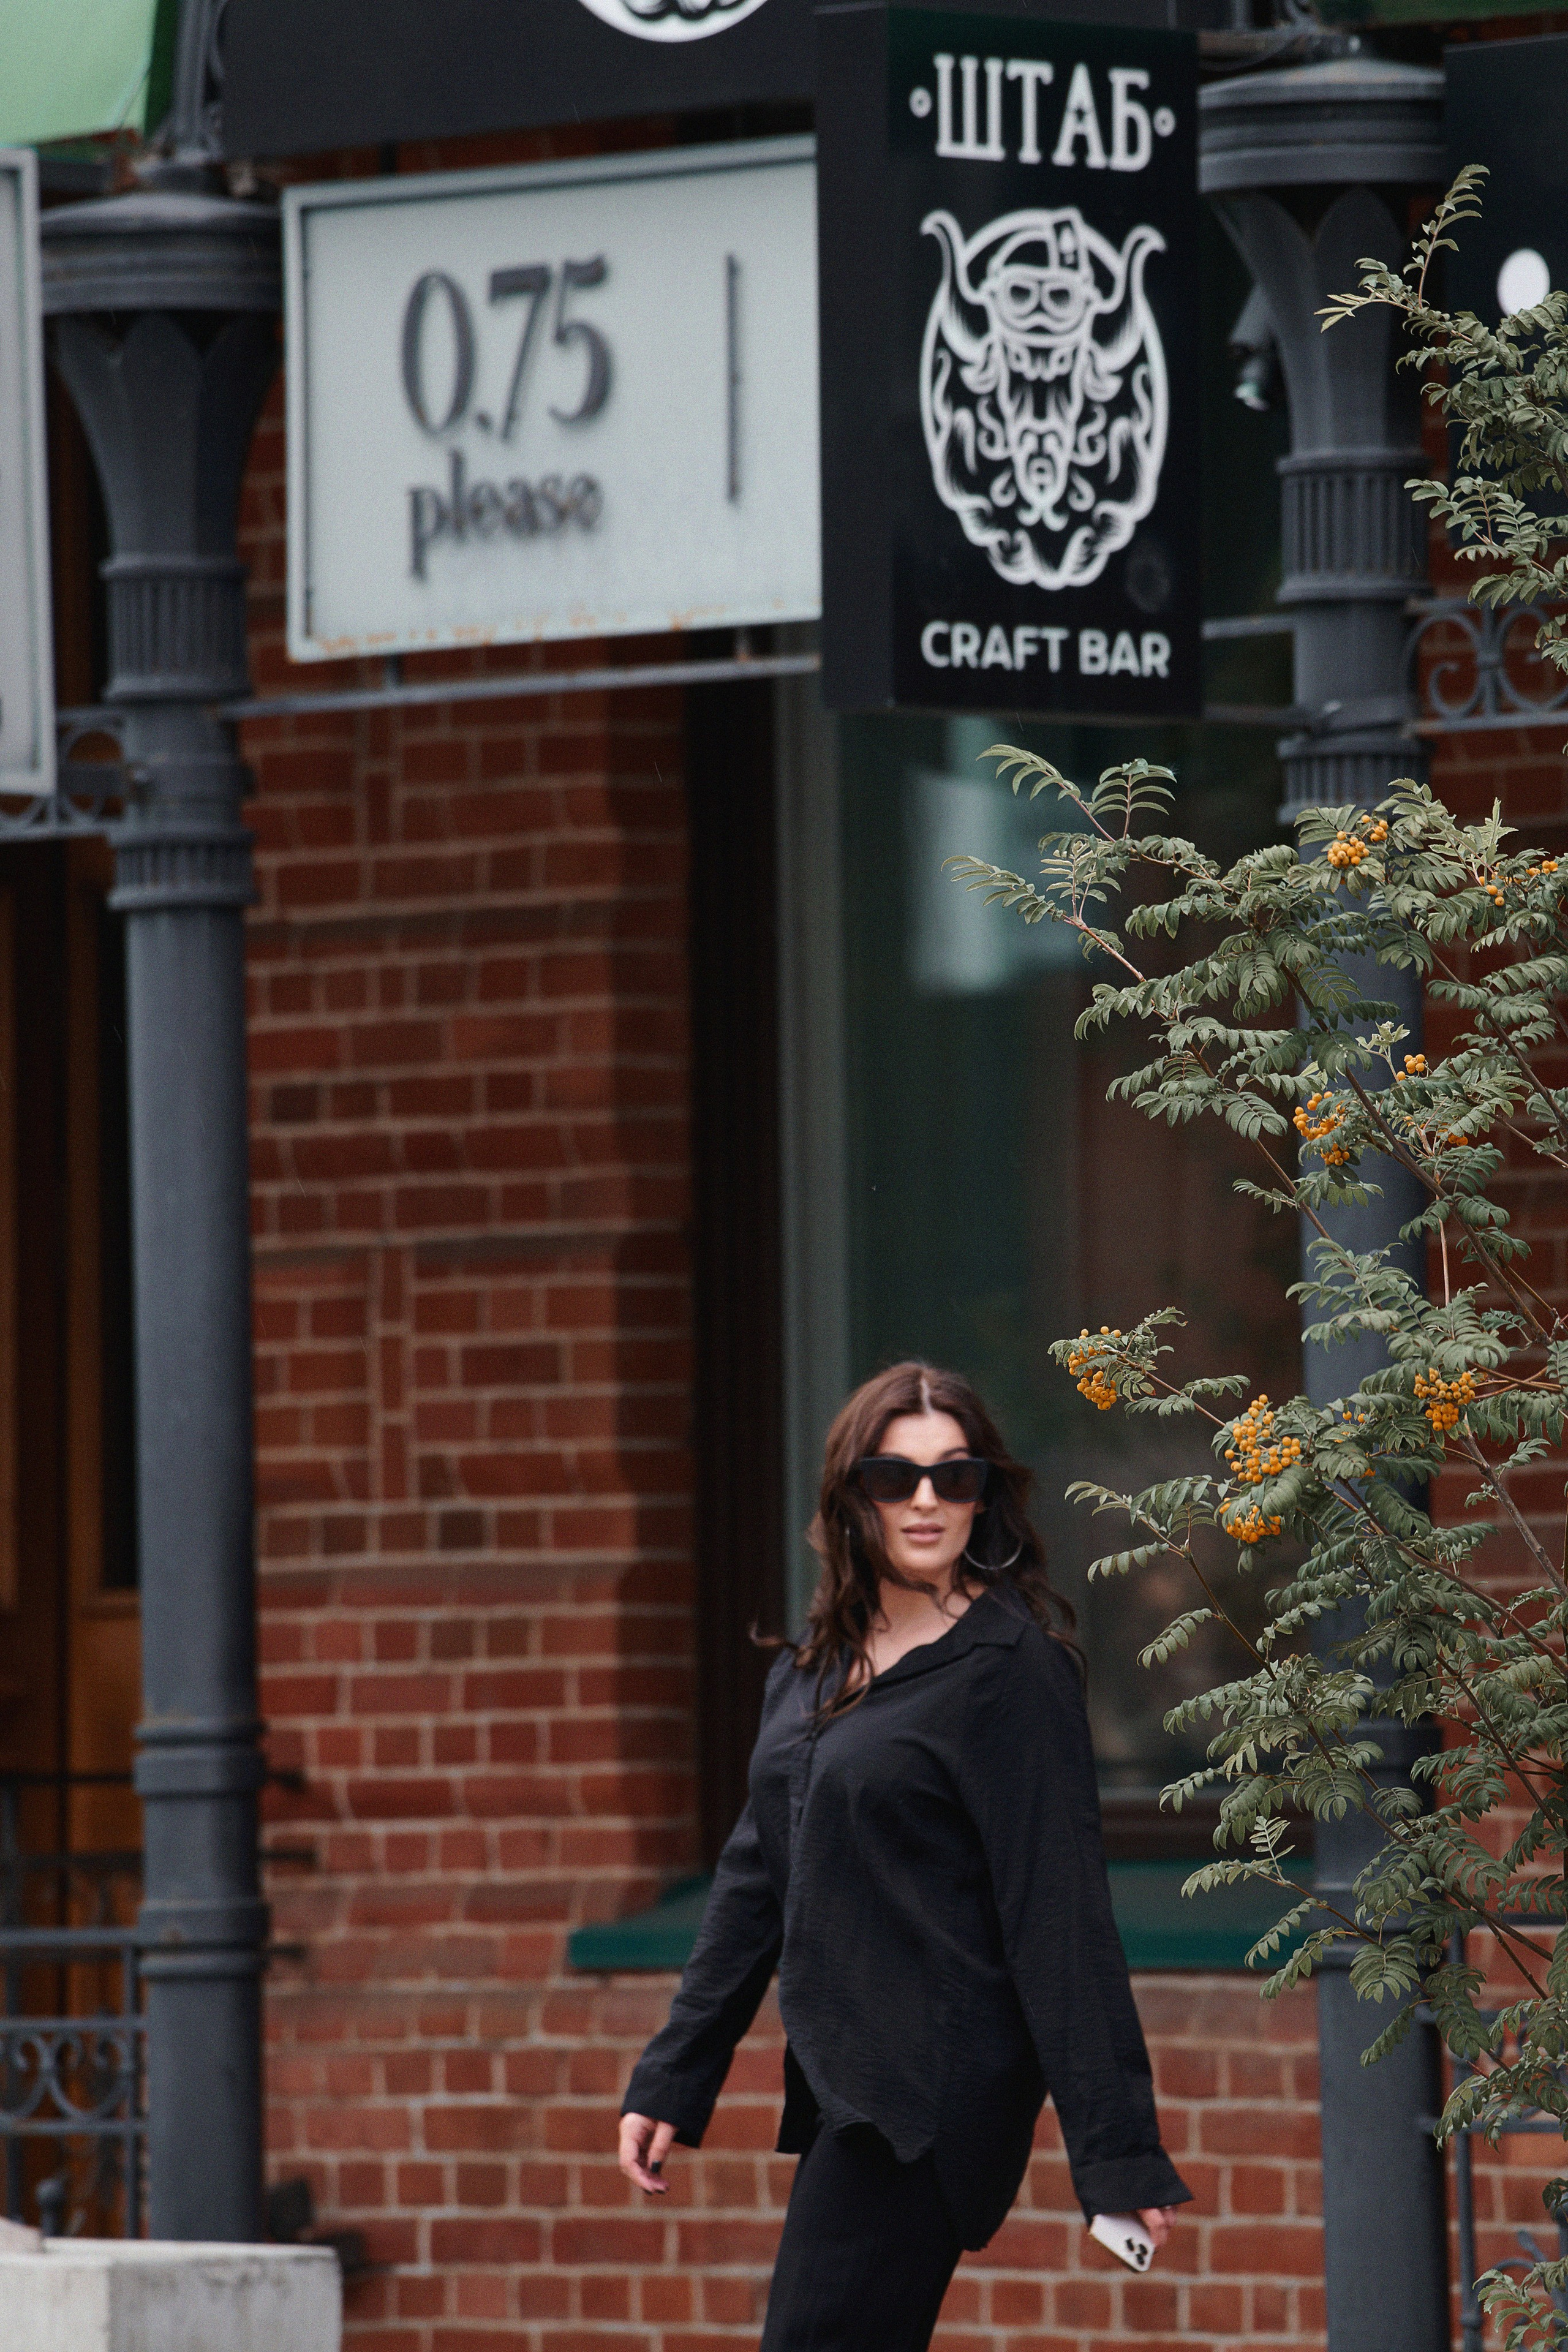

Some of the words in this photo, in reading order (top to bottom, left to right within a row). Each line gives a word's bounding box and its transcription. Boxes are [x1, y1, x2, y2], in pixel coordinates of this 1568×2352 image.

[933, 53, 1153, 172] ШТАБ
[401, 254, 614, 443] 0.75
[409, 447, 605, 584] please
[921, 620, 1069, 673] CRAFT
[1077, 628, 1171, 678] BAR
